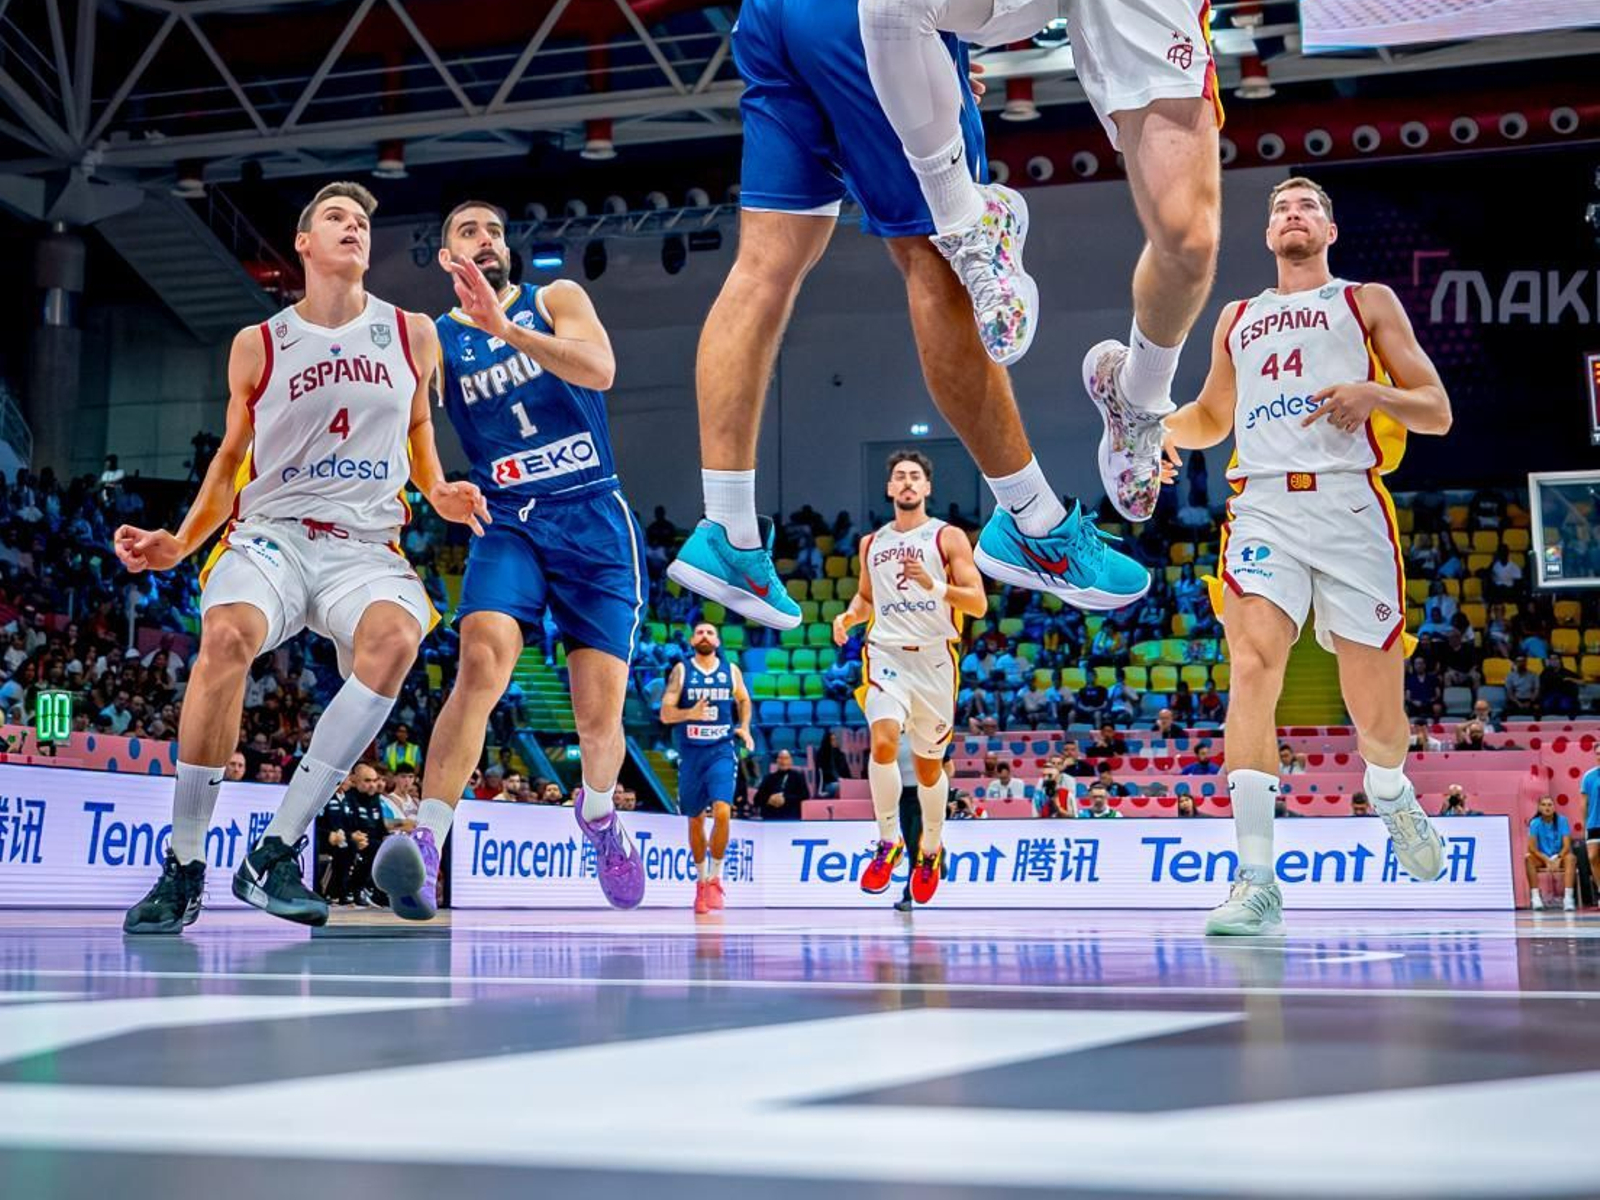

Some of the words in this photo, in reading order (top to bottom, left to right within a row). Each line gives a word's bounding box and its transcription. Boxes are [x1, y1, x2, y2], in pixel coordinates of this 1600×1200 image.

[1241, 307, 1329, 350] ESPAÑA
[289, 354, 393, 402] ESPAÑA
[460, 352, 544, 404] CYPRU
[1261, 348, 1303, 380] 44
[329, 408, 349, 440] 4
[511, 402, 538, 439] 1
[1246, 394, 1327, 429] endes
[522, 440, 593, 474] EKO
[39, 693, 70, 739] 00
[84, 801, 242, 868] Tencnt
[468, 822, 577, 877] Tencent
[1013, 837, 1100, 882] 腾讯
[1141, 837, 1374, 882] Tenent
